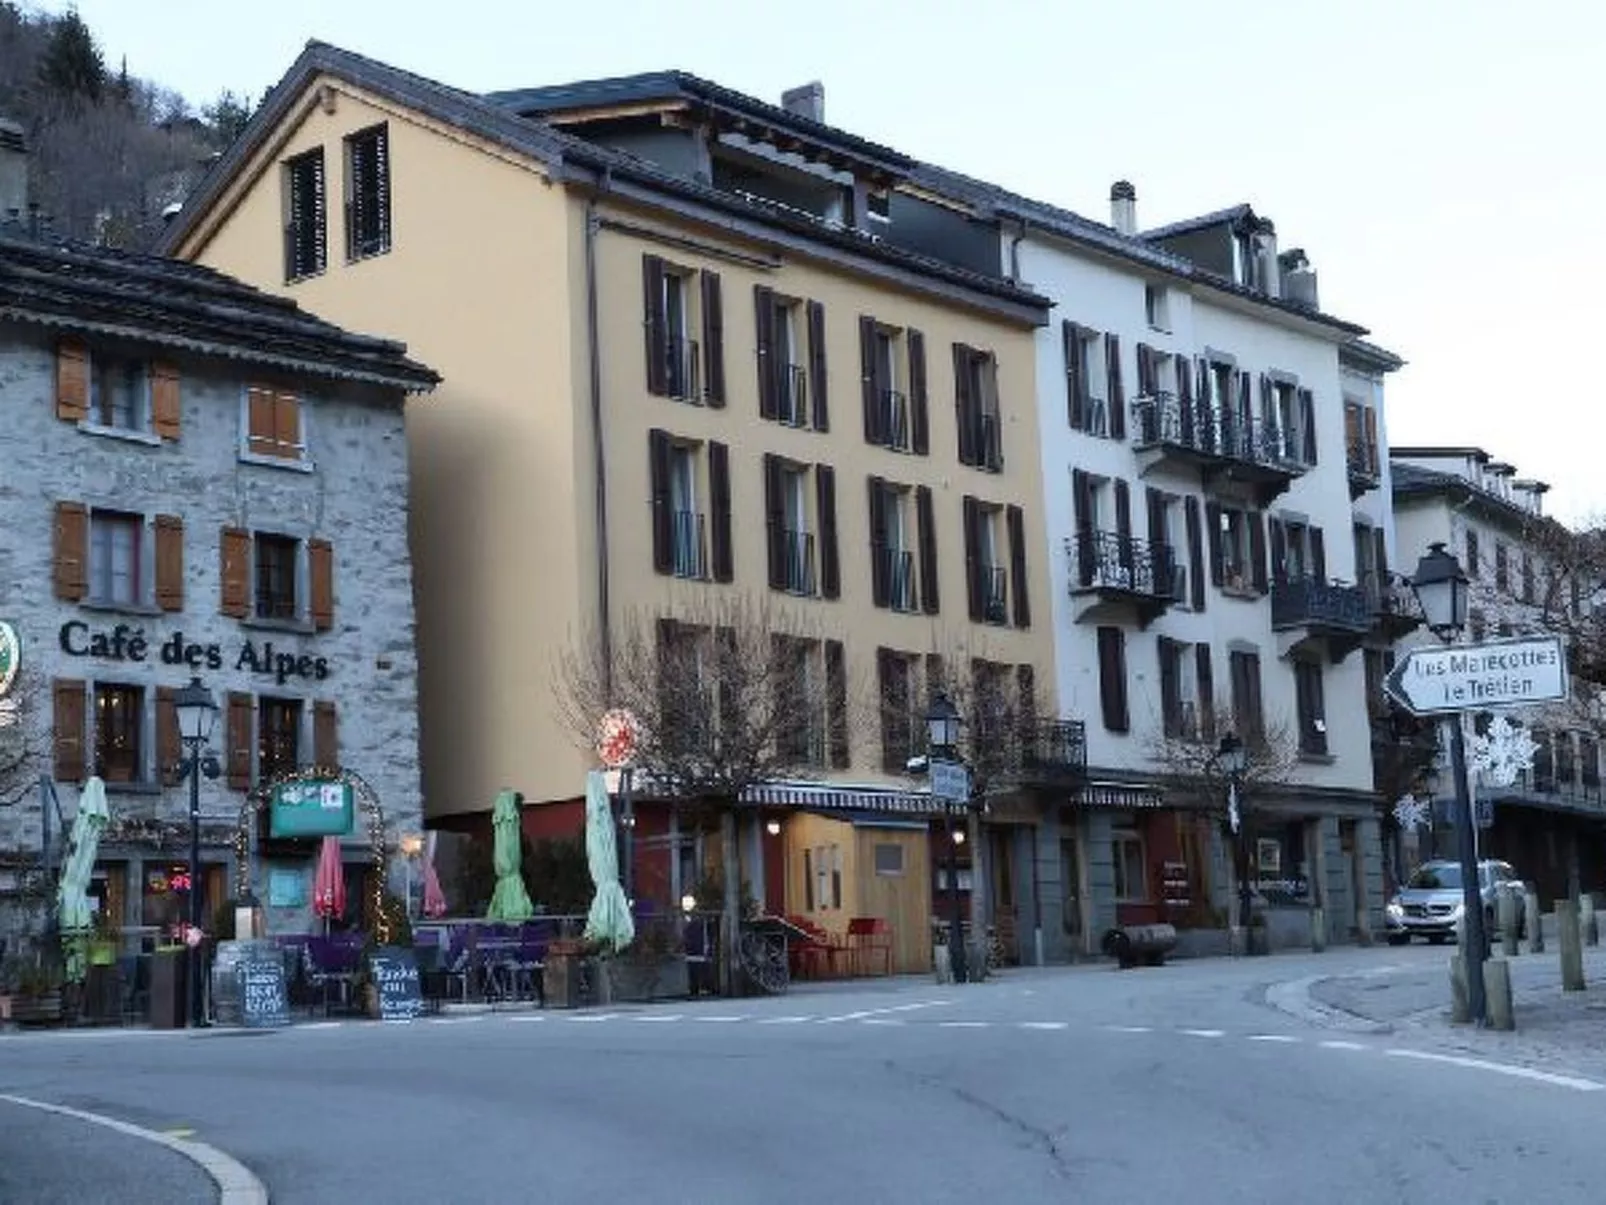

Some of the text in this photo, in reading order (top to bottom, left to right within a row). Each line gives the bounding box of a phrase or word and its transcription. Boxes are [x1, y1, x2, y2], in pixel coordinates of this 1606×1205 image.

[59, 620, 329, 685] Café des Alpes
